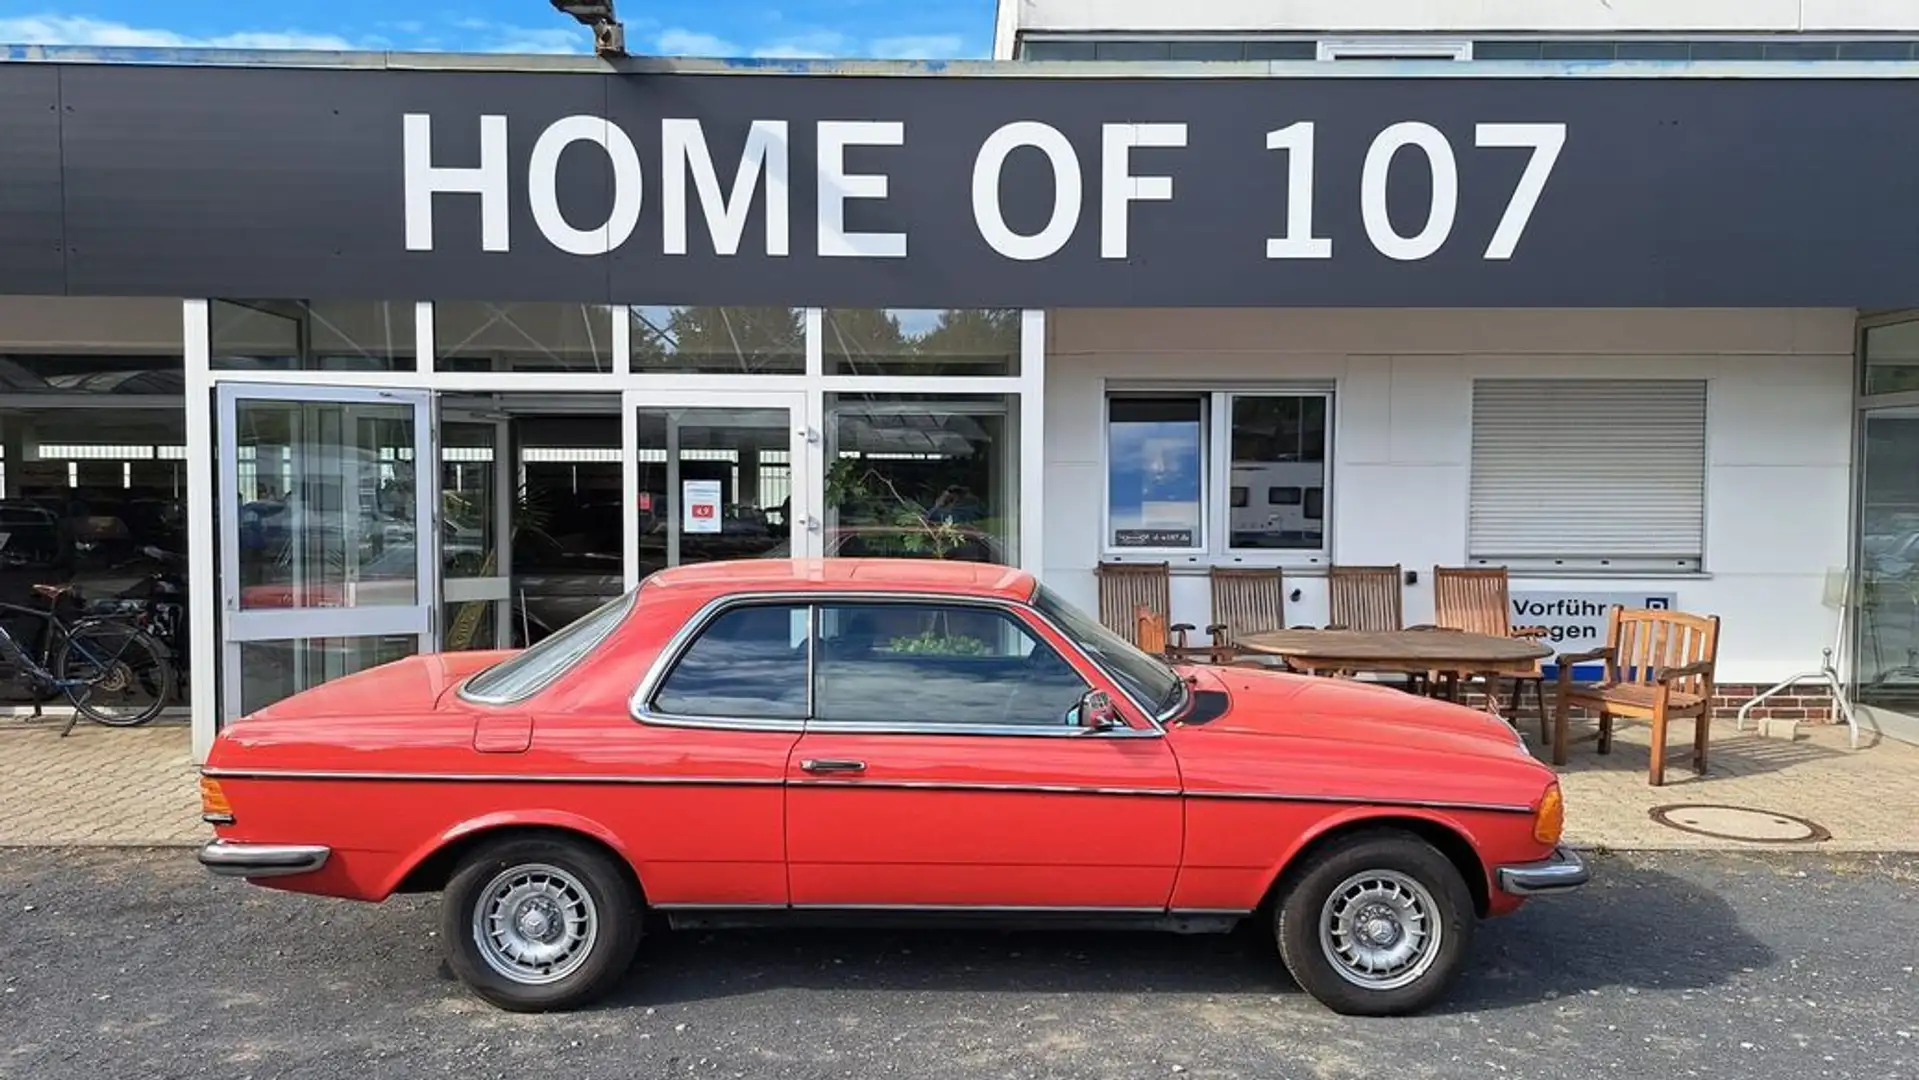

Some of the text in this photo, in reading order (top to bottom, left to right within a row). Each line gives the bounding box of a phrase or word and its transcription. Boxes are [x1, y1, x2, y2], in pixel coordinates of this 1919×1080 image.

[404, 114, 1567, 260] HOME OF 107
[1513, 599, 1606, 617] Vorführ
